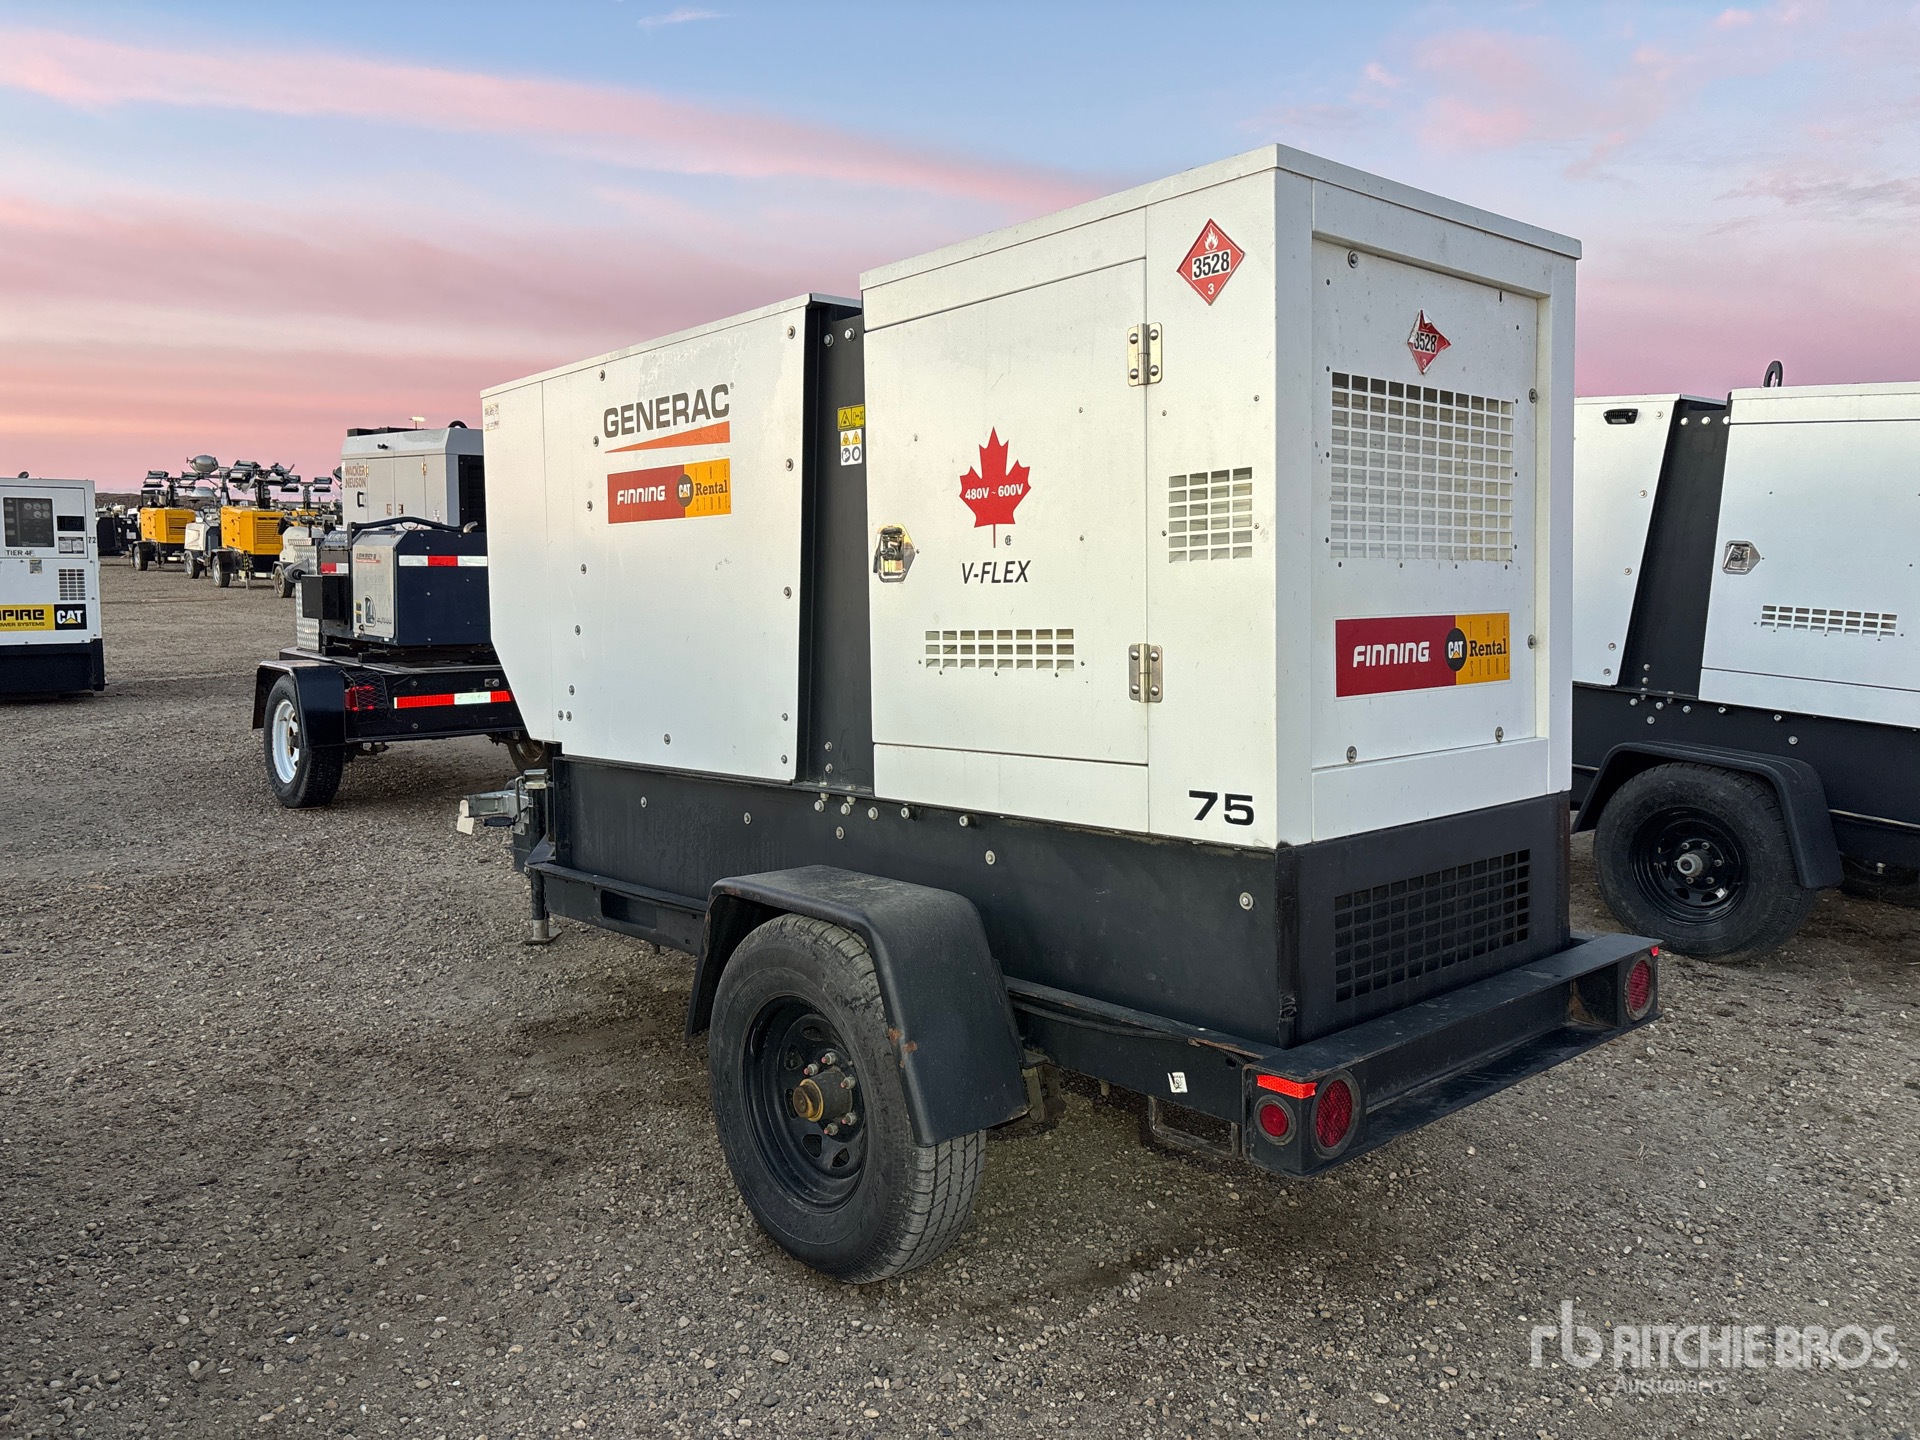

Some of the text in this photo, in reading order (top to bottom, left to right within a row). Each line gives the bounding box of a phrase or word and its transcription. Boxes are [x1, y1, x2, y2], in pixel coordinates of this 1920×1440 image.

[1193, 251, 1230, 278] 3528
[1207, 283, 1215, 295] 3
[1414, 331, 1437, 353] 3528
[603, 383, 730, 438] GENERAC
[616, 479, 728, 505] FINNING CAT Rental
[964, 487, 989, 500] 480V
[997, 483, 1024, 497] 600V
[962, 560, 1031, 584] V-FLEX
[0, 609, 45, 622] PIRE
[56, 610, 84, 624] CAT
[1352, 638, 1507, 668] FINNING CAT Rental
[1188, 789, 1254, 826] 75
